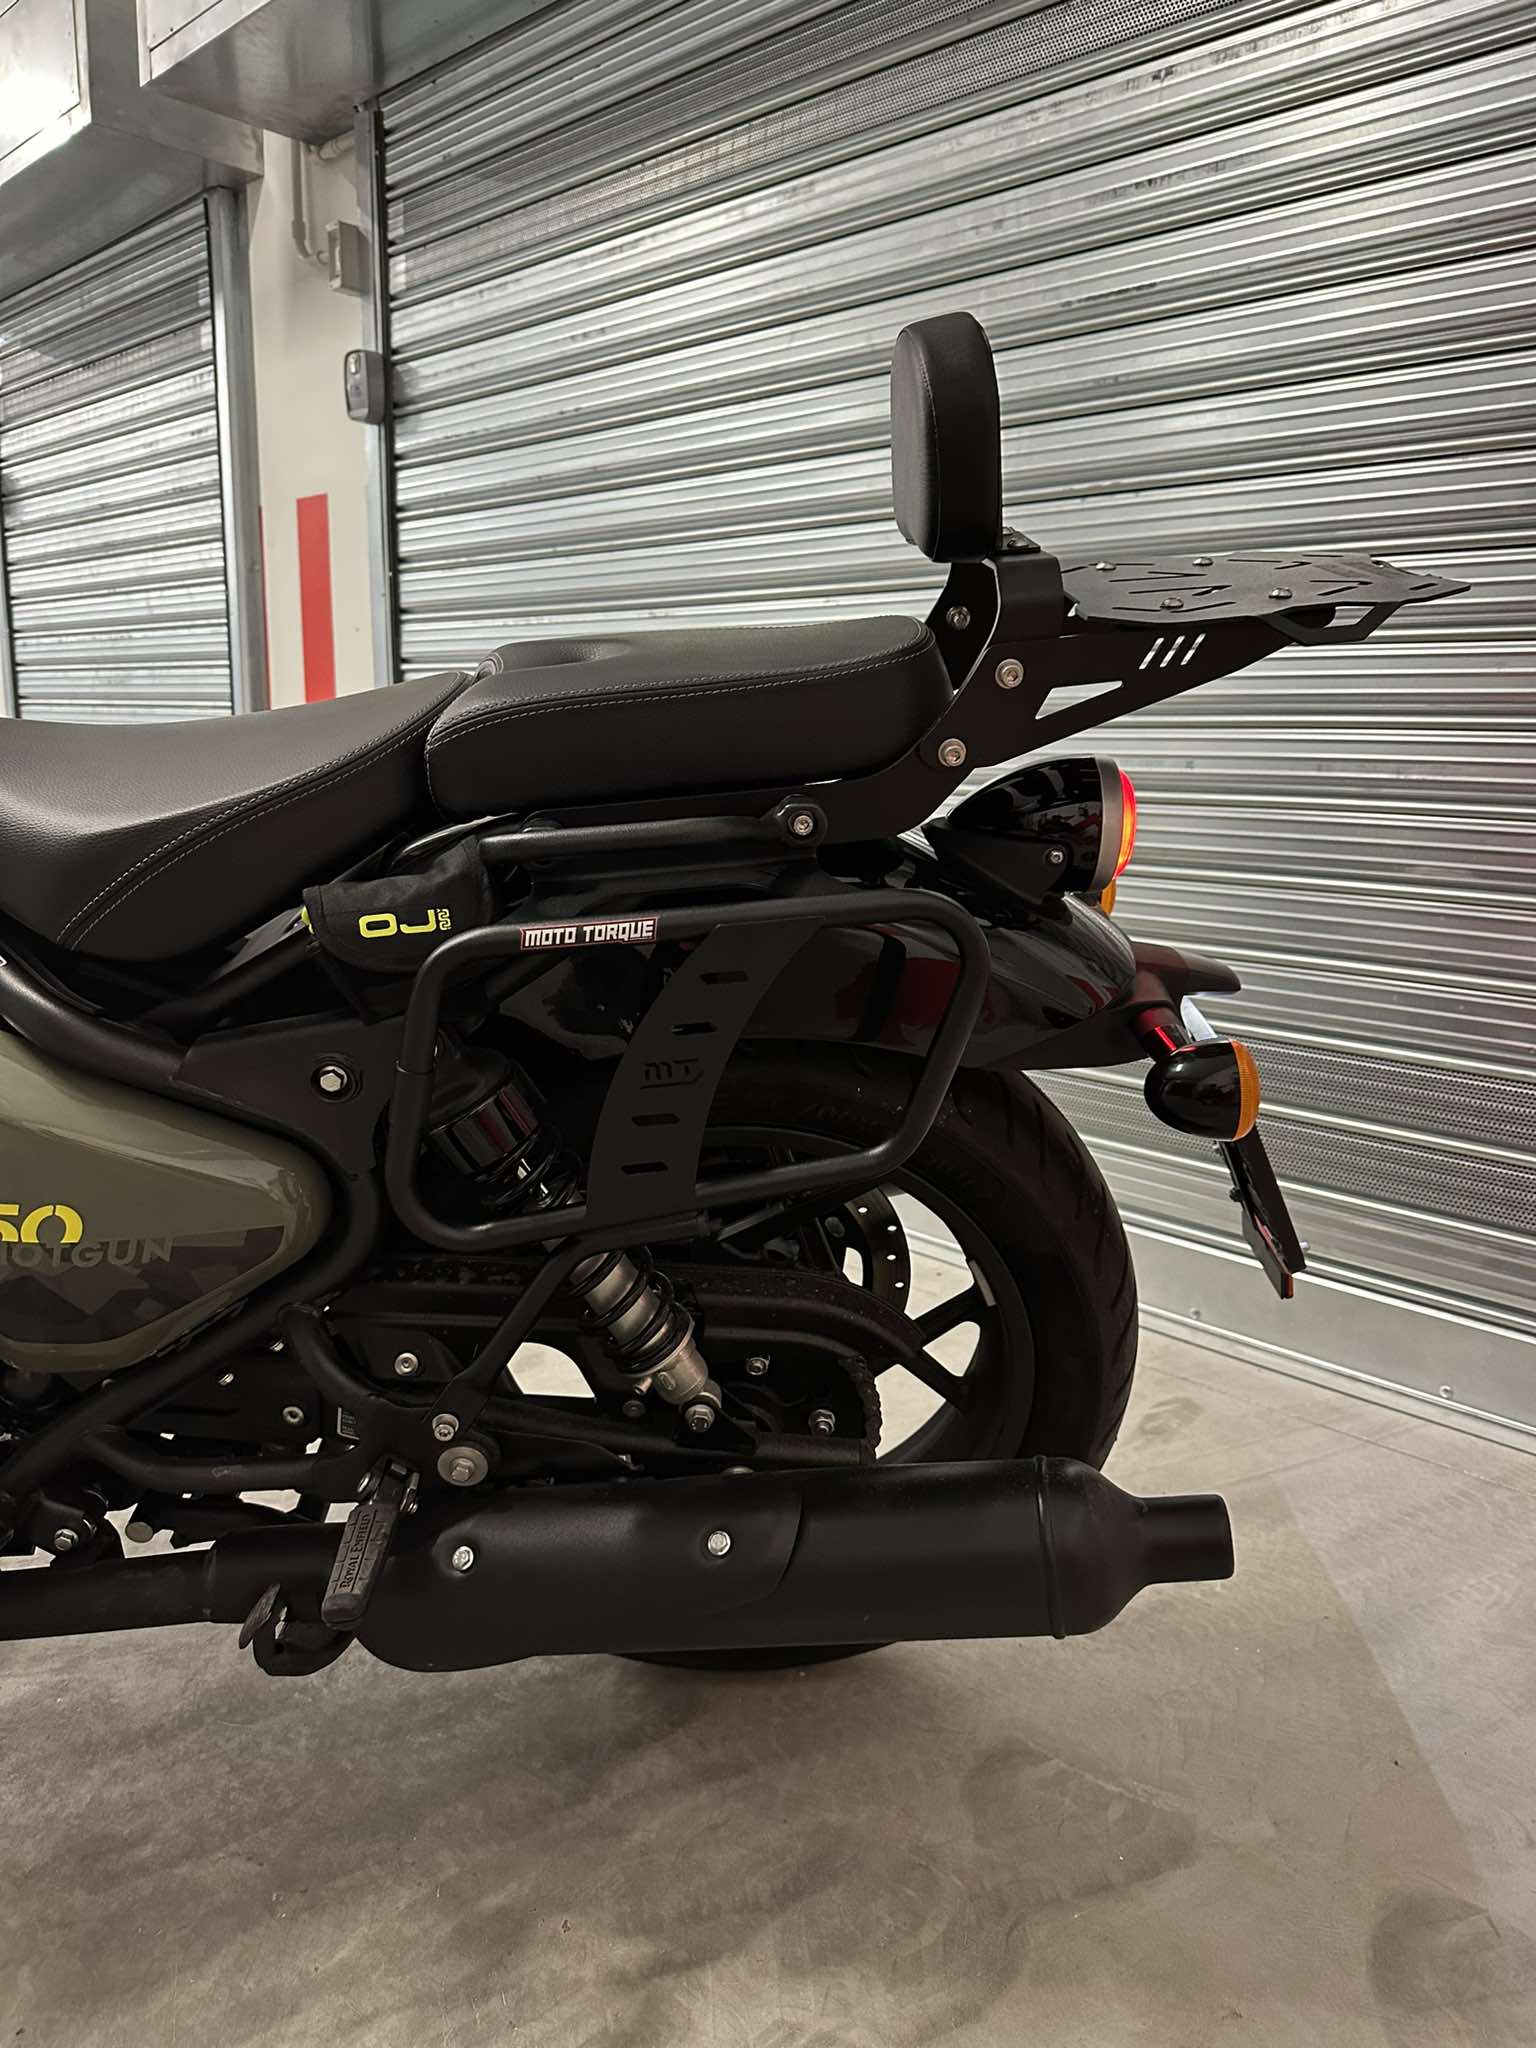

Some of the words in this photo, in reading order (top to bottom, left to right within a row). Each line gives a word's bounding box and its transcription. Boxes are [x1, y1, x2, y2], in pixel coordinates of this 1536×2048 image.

[524, 926, 577, 947] MOTO
[583, 920, 654, 942] TORQUE
[339, 1554, 360, 1589] ROYAL
